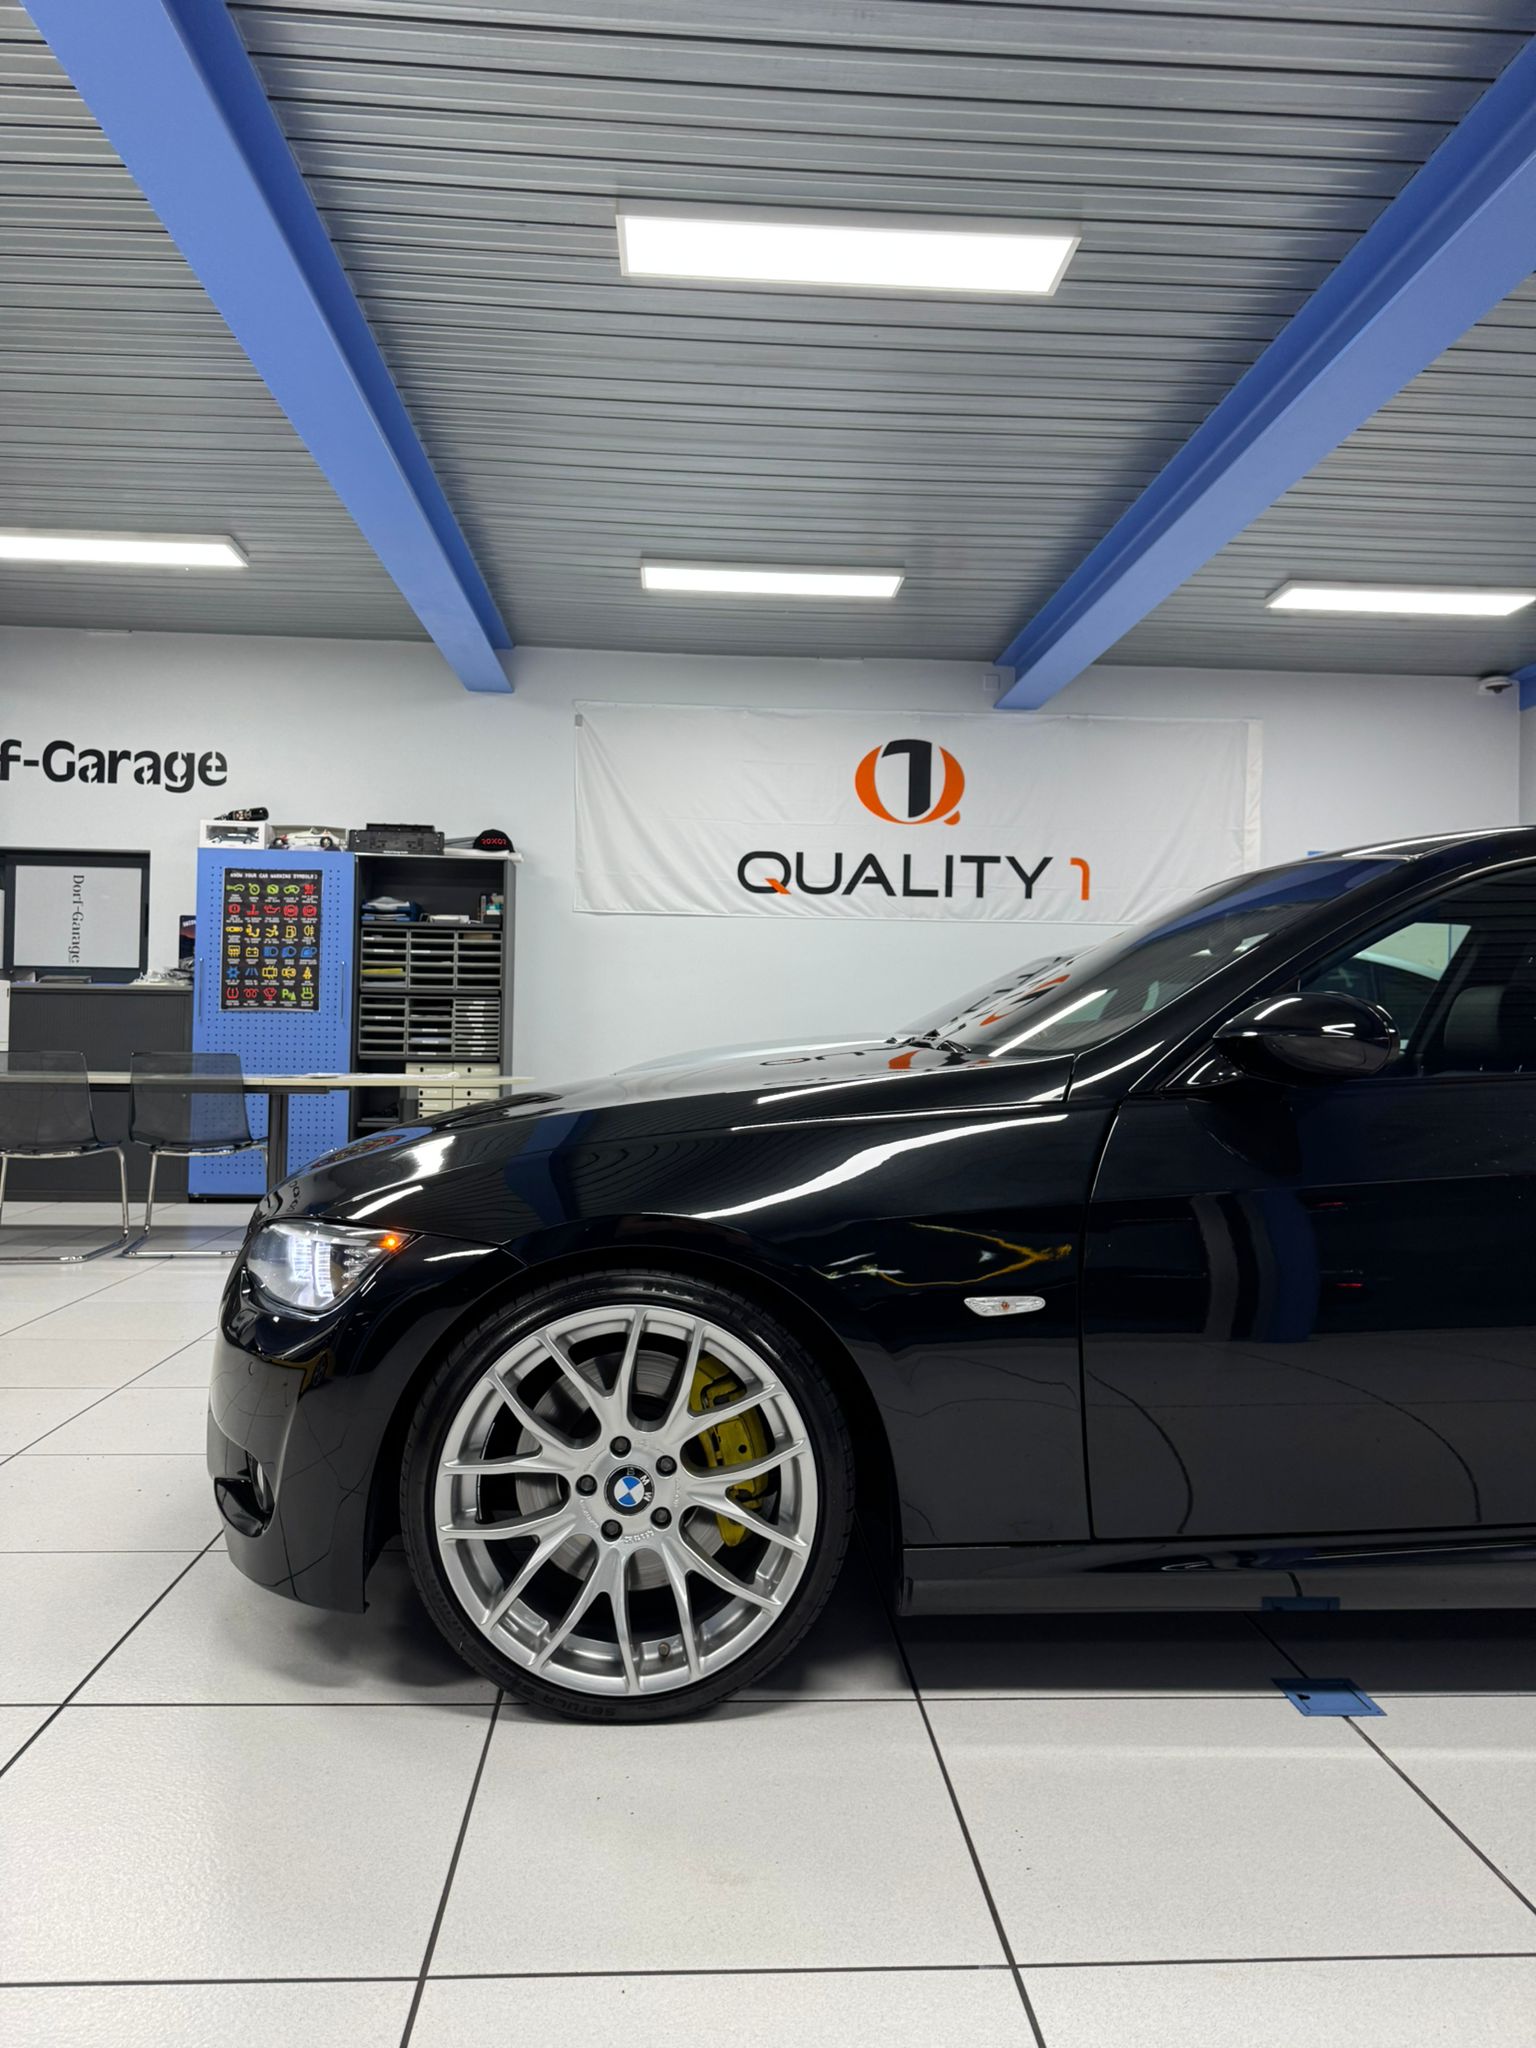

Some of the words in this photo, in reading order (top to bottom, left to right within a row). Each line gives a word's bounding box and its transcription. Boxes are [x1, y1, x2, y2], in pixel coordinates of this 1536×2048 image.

[0, 739, 228, 793] f-Garage
[738, 851, 1053, 900] QUALITY
[1069, 857, 1091, 902] 1
[68, 874, 85, 964] Dorf-Garage
[626, 1466, 653, 1502] BMW
